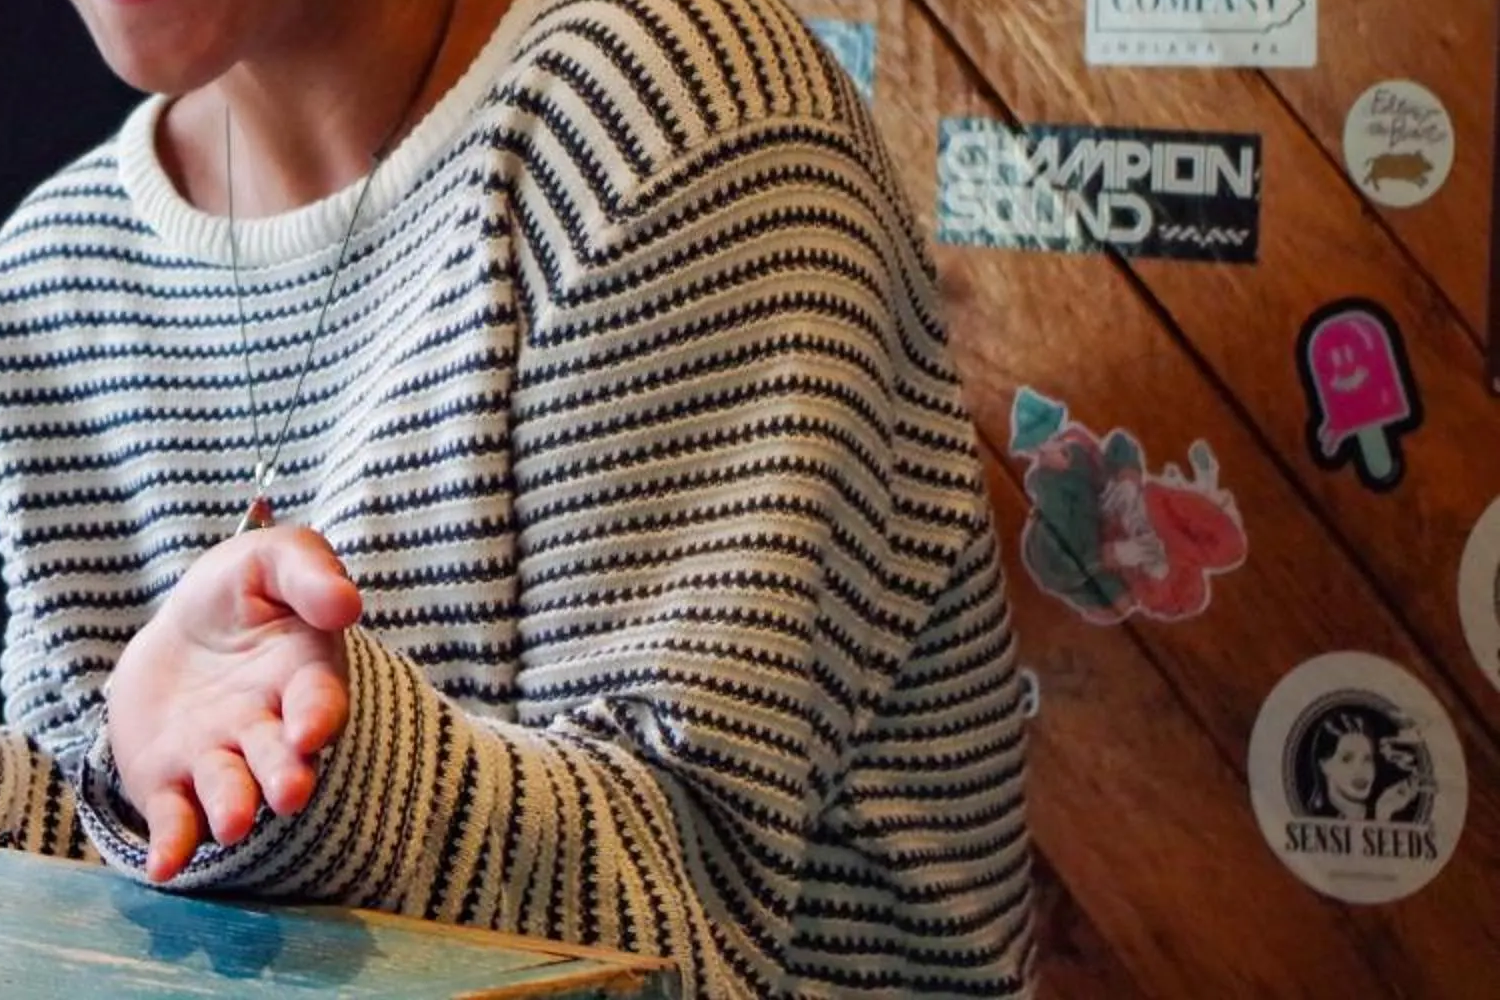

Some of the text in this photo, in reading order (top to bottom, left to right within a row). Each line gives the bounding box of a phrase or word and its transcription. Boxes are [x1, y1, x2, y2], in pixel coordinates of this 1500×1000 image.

[944, 132, 1253, 199] CHAMPION
[941, 188, 1154, 244] SOUND
[1285, 822, 1438, 860] SENSI SEEDS
